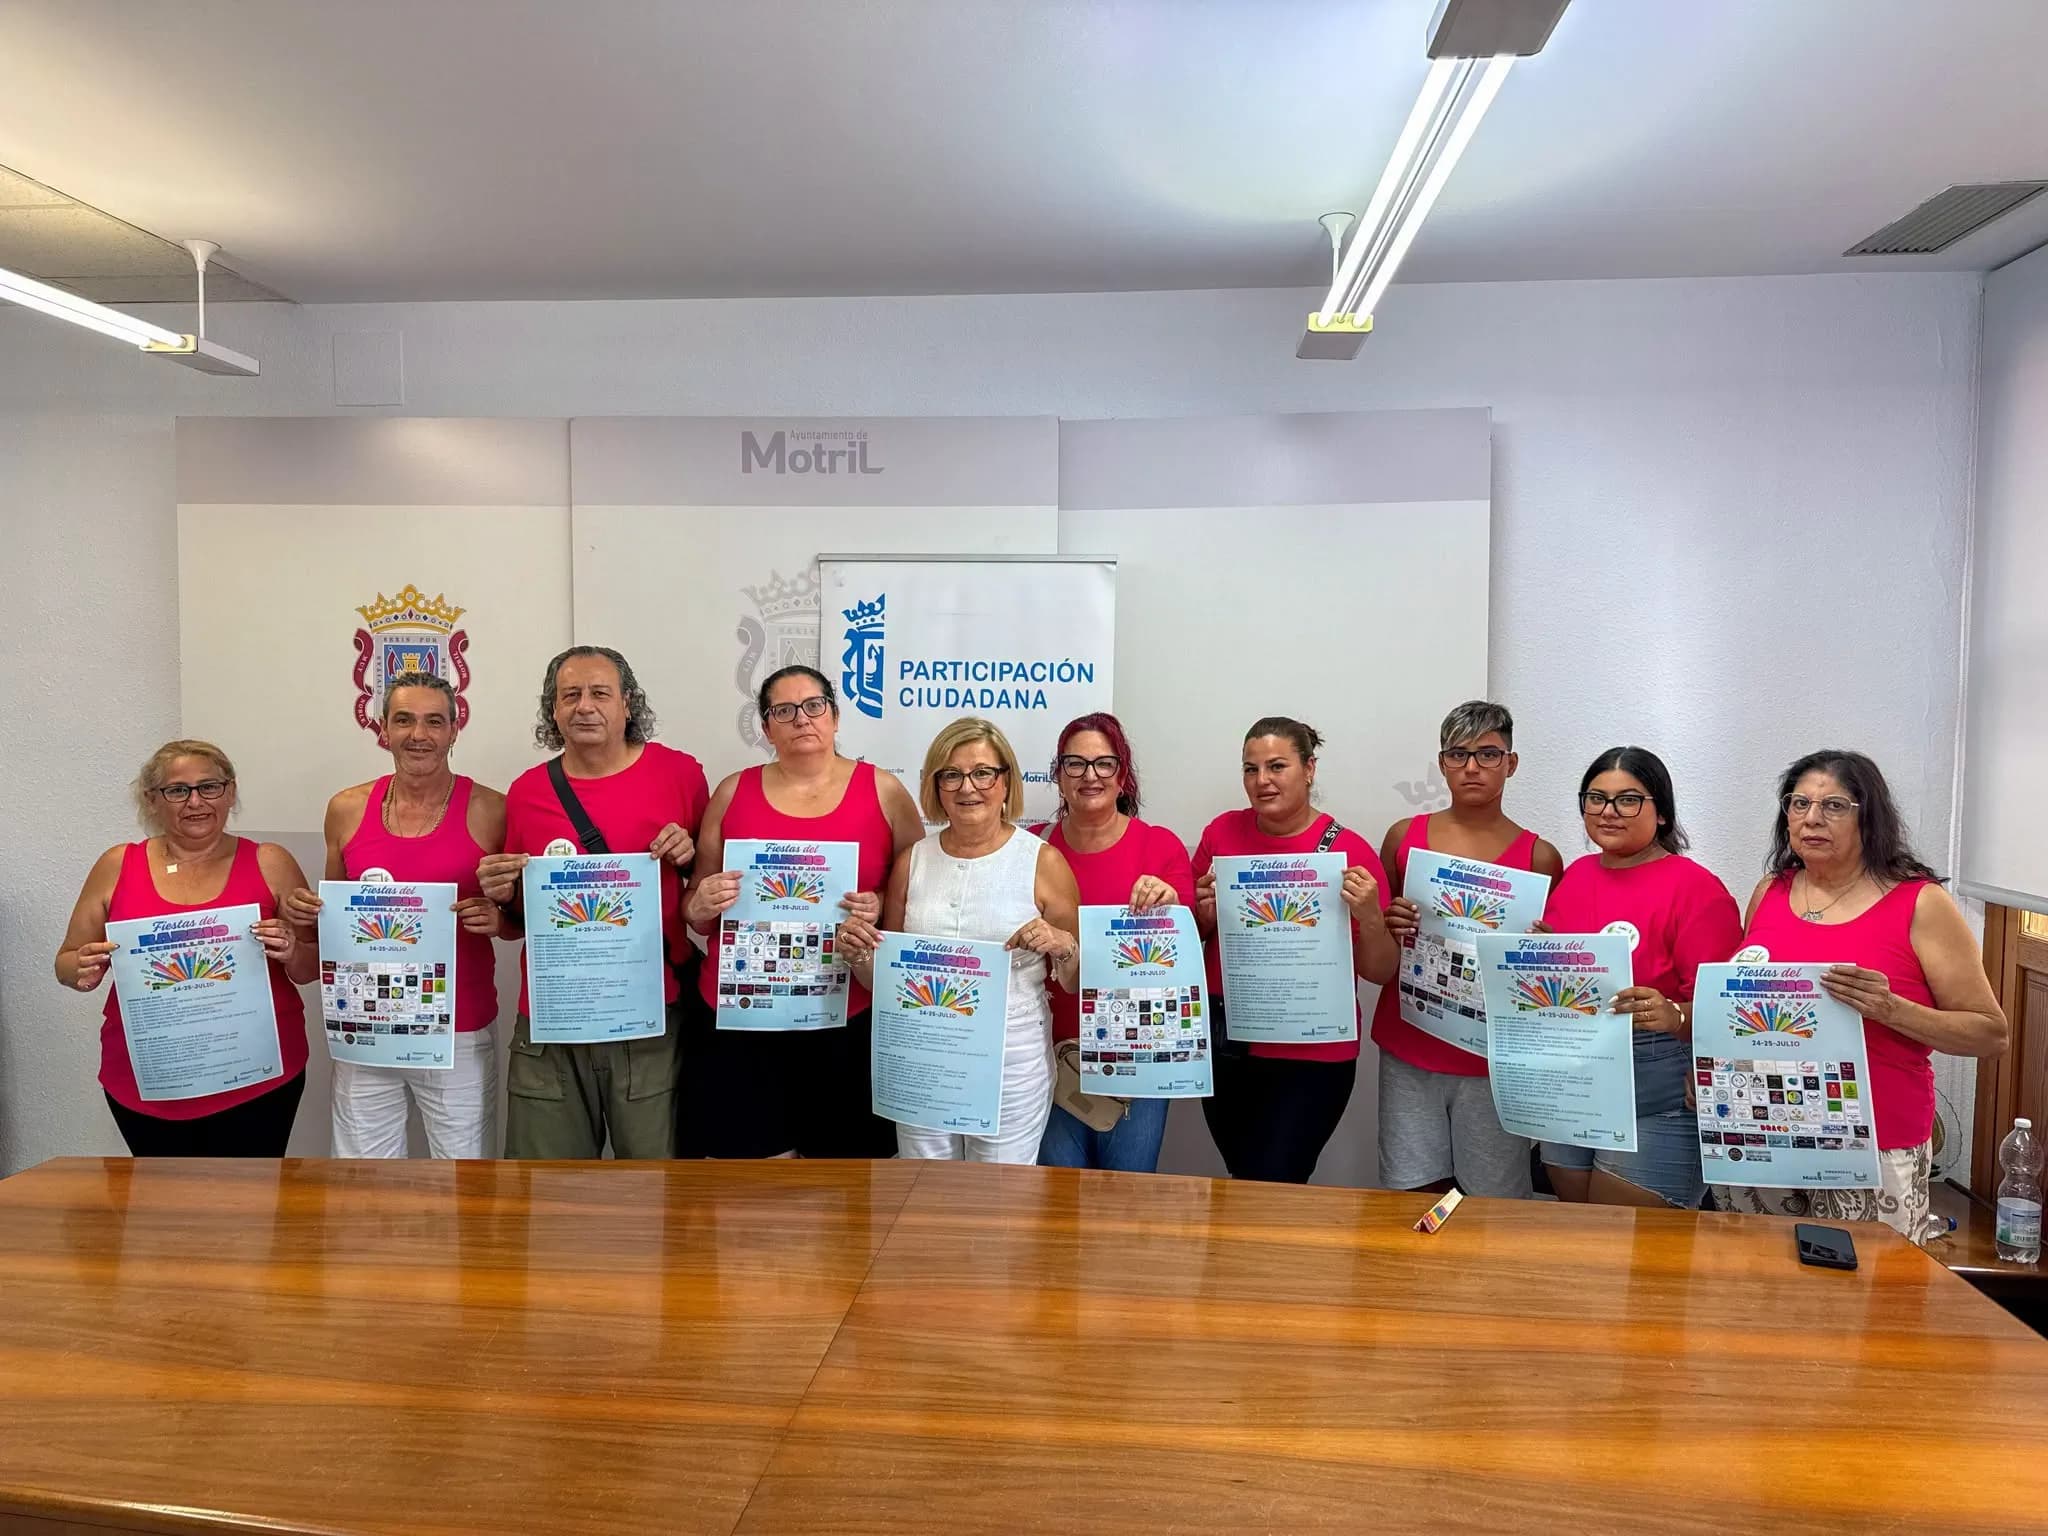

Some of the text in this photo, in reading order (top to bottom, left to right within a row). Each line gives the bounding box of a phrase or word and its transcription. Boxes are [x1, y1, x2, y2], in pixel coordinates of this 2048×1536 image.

[790, 430, 868, 440] Ayuntamiento de
[900, 658, 1094, 683] PARTICIPACIÓN
[900, 687, 1048, 709] CIUDADANA
[765, 843, 819, 853] Fiestas del
[563, 859, 622, 870] Fiestas del
[1251, 859, 1309, 870] Fiestas del
[1449, 860, 1486, 874] Fiestas
[361, 885, 397, 894] Fiestas
[153, 915, 218, 932] Fiestas del
[914, 940, 973, 954] Fiestas del
[1519, 939, 1585, 950] Fiestas del
[901, 950, 980, 969] BARRIO
[1505, 952, 1595, 965] BARRIO
[1736, 966, 1802, 977] Fiestas del
[1727, 979, 1813, 992] BARRIO
